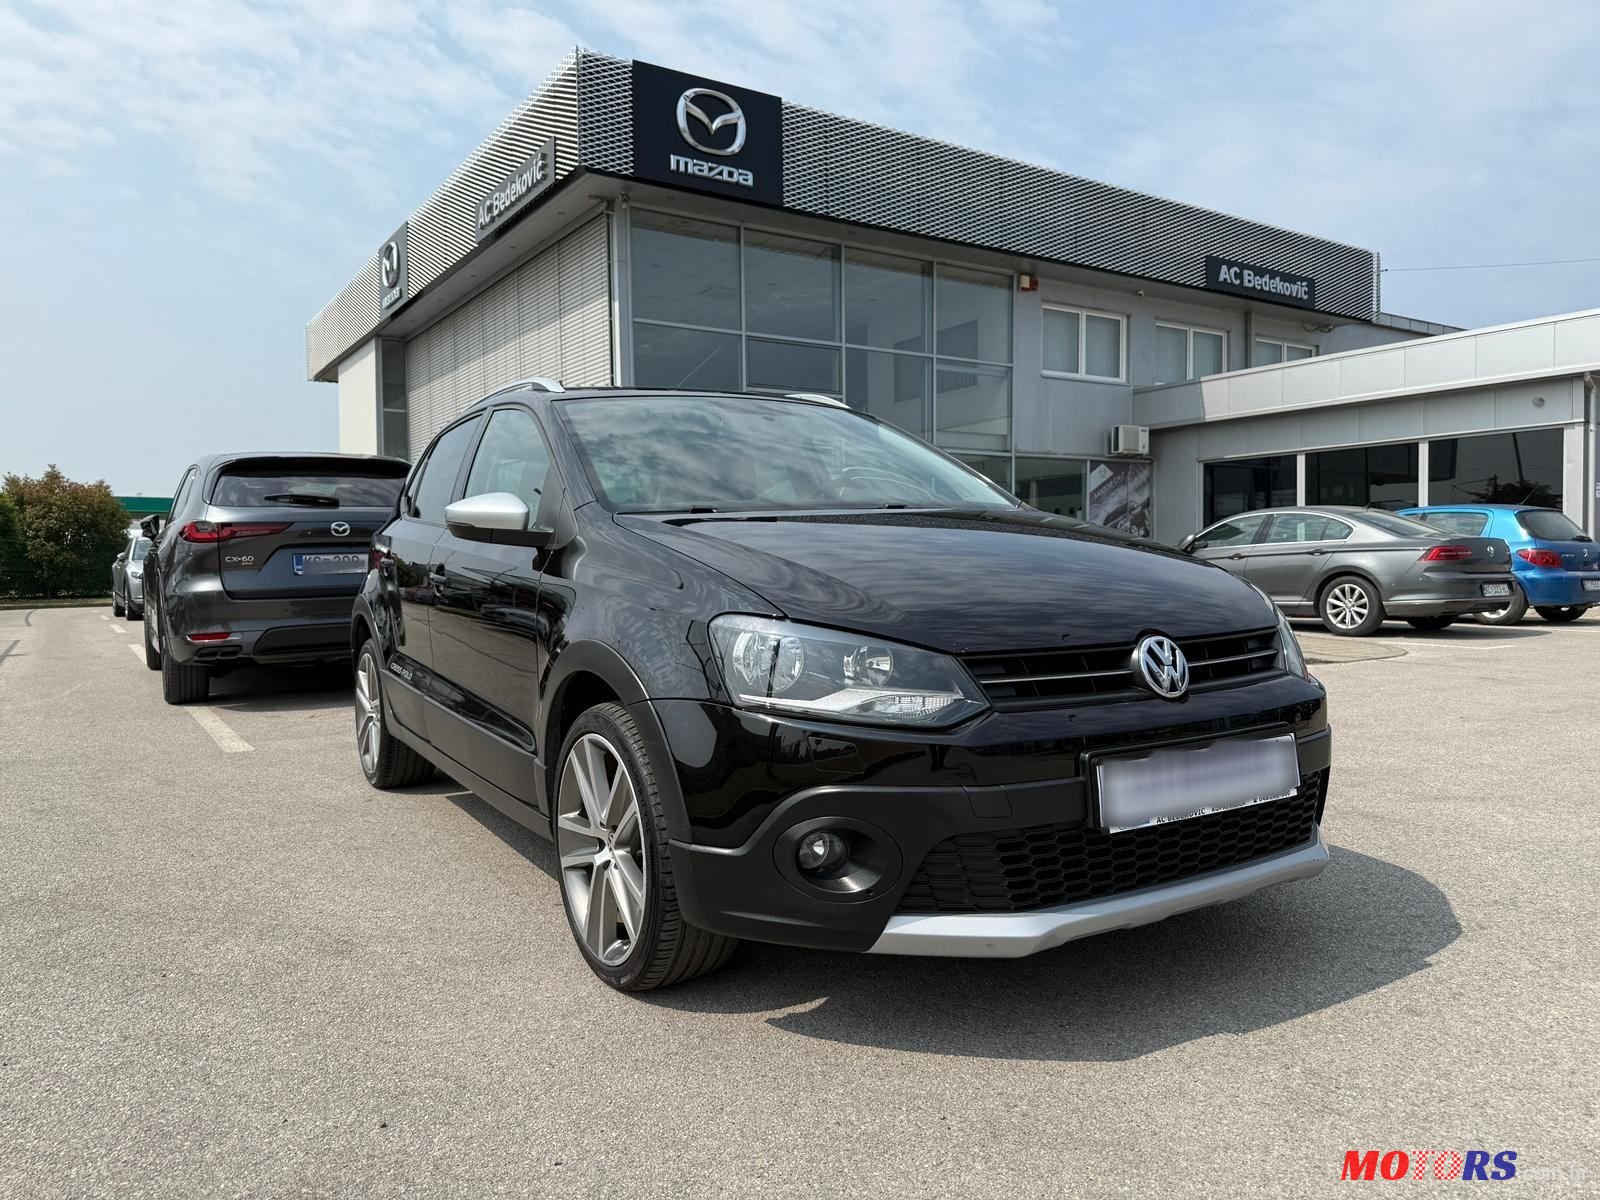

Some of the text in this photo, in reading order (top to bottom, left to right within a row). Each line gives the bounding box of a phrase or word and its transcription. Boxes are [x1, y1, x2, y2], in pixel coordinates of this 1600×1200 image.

[478, 152, 546, 229] AC Bedeković
[1218, 264, 1309, 300] AC Bedeković
[225, 555, 255, 563] CX-60
